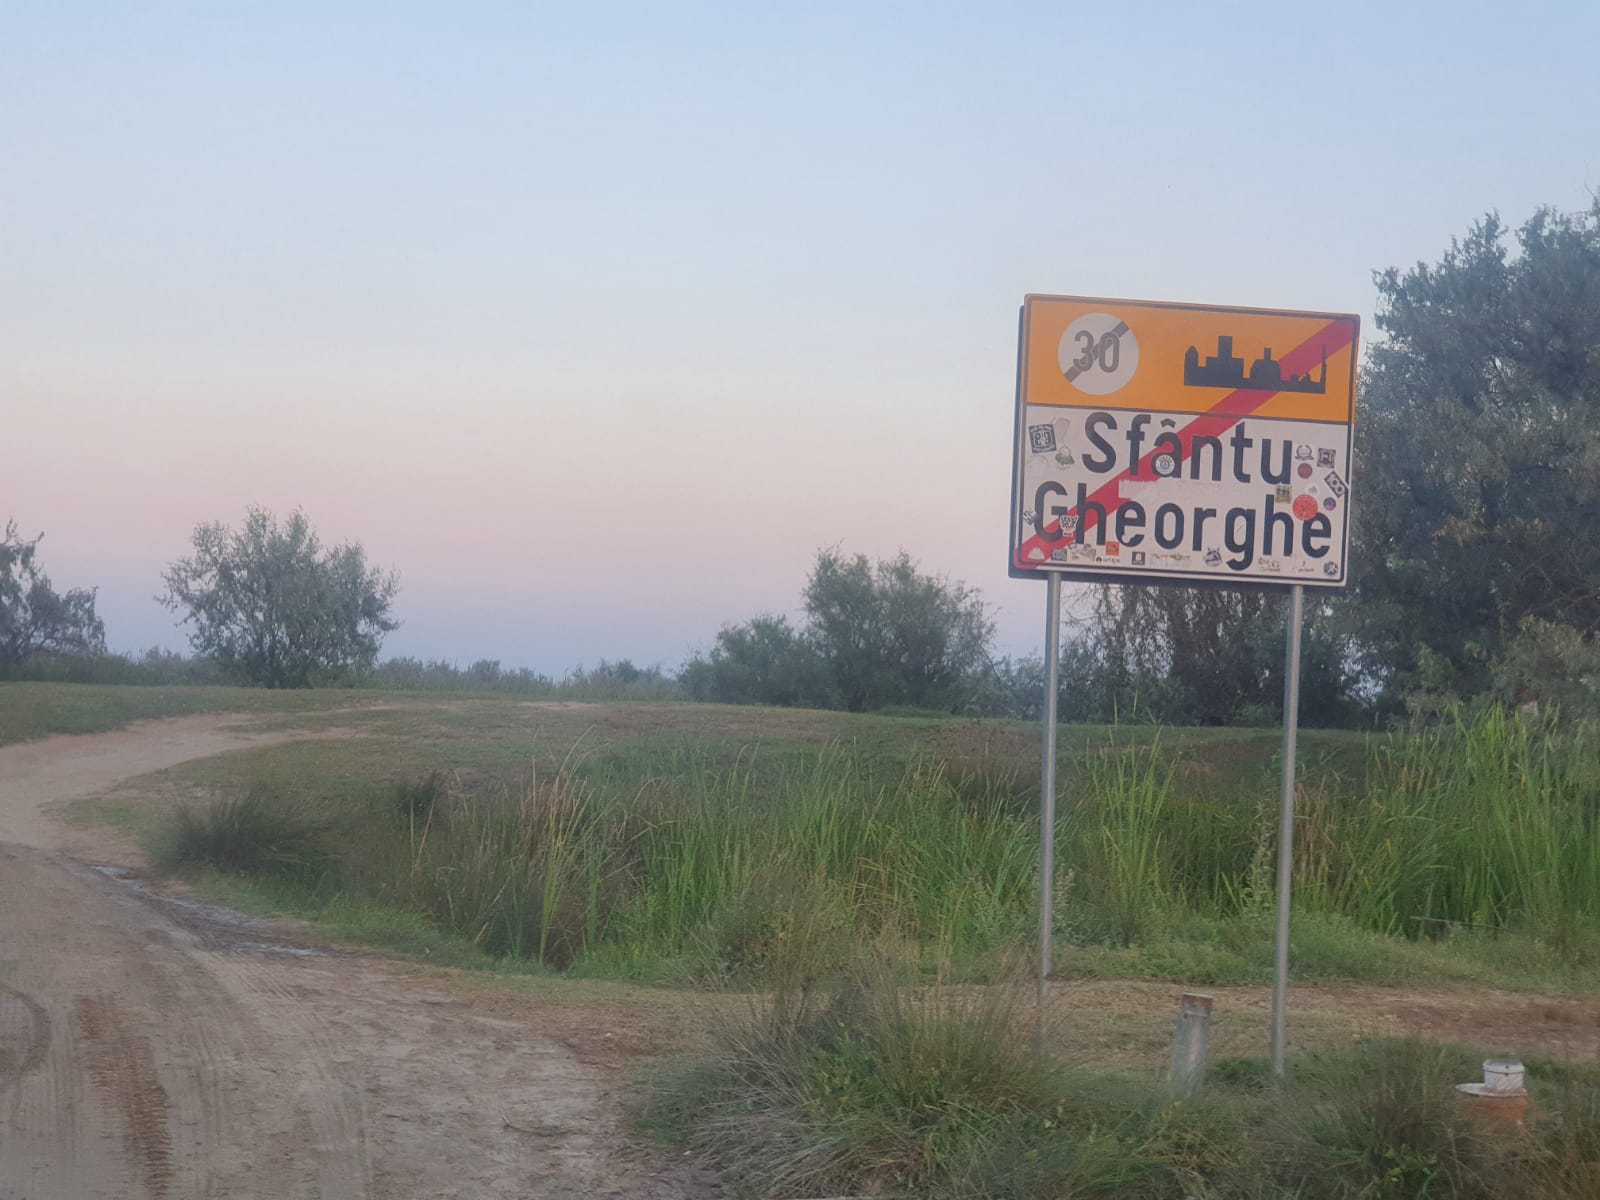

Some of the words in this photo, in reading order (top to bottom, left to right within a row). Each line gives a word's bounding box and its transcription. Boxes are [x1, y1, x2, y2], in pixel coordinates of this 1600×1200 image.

[1073, 330, 1120, 373] 30
[1082, 412, 1293, 485] Sfântu
[1034, 480, 1332, 572] Gheorghe
